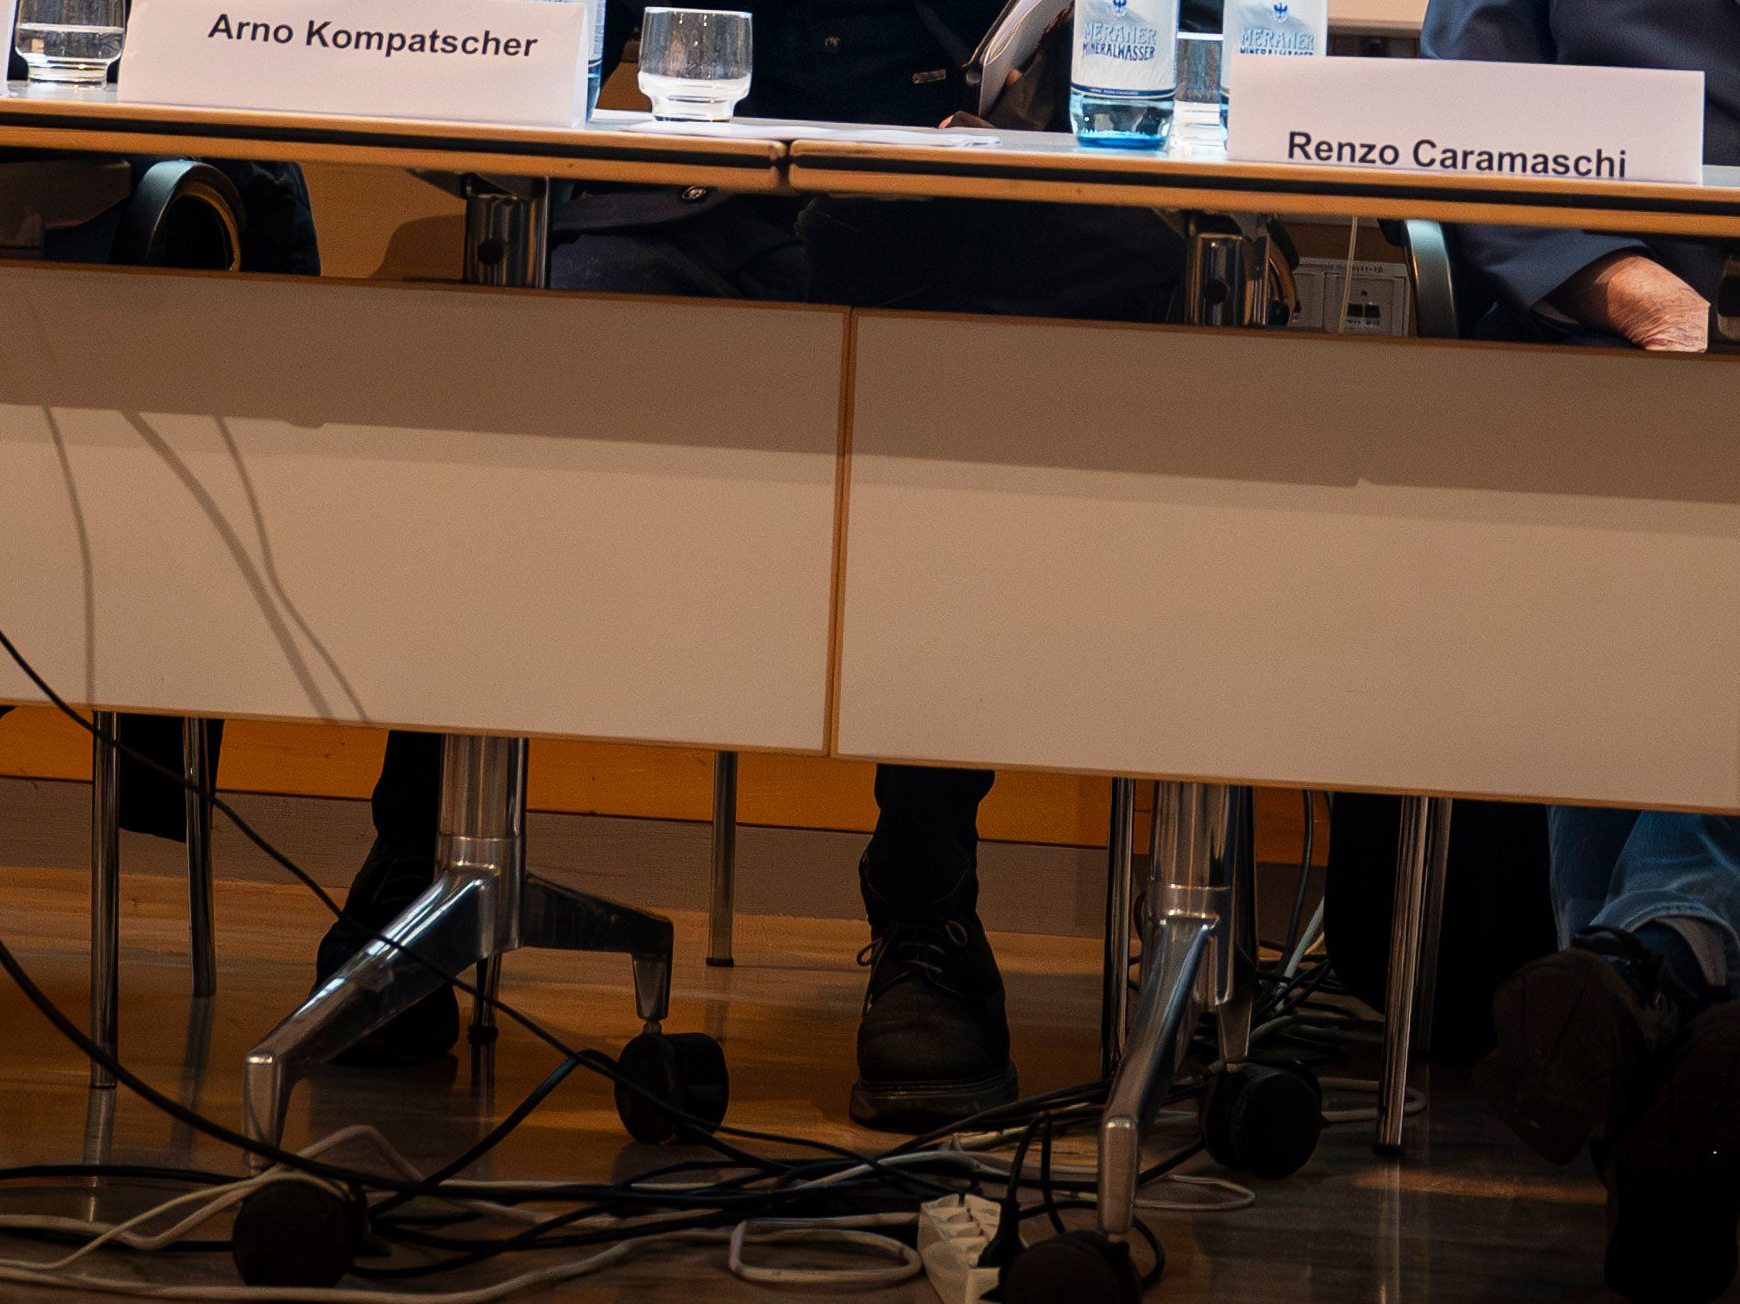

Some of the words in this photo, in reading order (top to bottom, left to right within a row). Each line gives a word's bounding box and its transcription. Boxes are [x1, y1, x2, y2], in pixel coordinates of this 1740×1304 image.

[208, 14, 293, 43] Arno
[306, 21, 538, 57] Kompatscher
[1084, 22, 1156, 45] MERANER
[1082, 43, 1155, 61] MINERALWASSER
[1288, 131, 1399, 165] Renzo
[1412, 139, 1626, 178] Caramaschi
